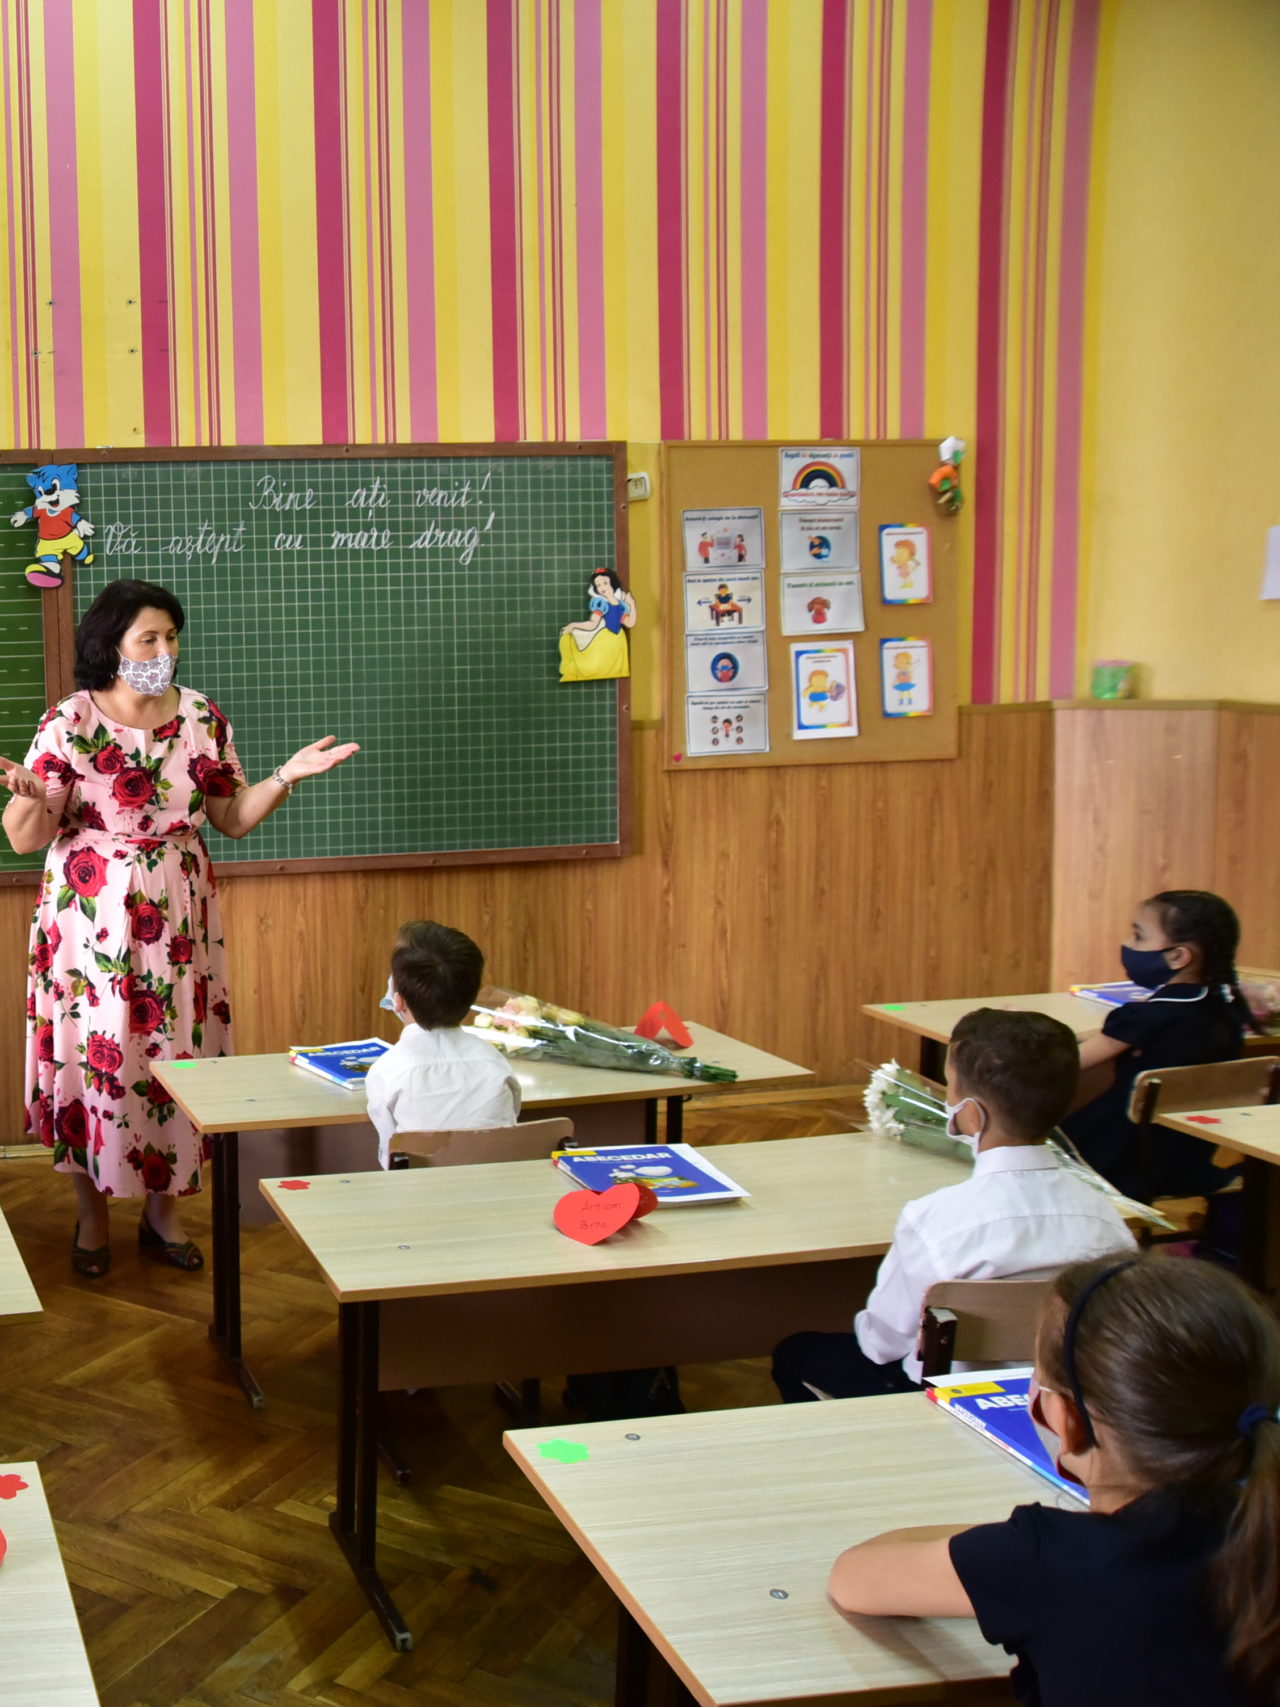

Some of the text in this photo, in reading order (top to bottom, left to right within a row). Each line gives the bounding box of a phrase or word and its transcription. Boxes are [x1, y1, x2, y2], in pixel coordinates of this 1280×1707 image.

[249, 472, 491, 521] Bine ați venit!
[105, 522, 142, 555] Vă
[274, 532, 304, 550] cu
[331, 527, 394, 550] mare
[409, 511, 495, 565] drag!
[572, 1152, 672, 1162] ABECEDAR
